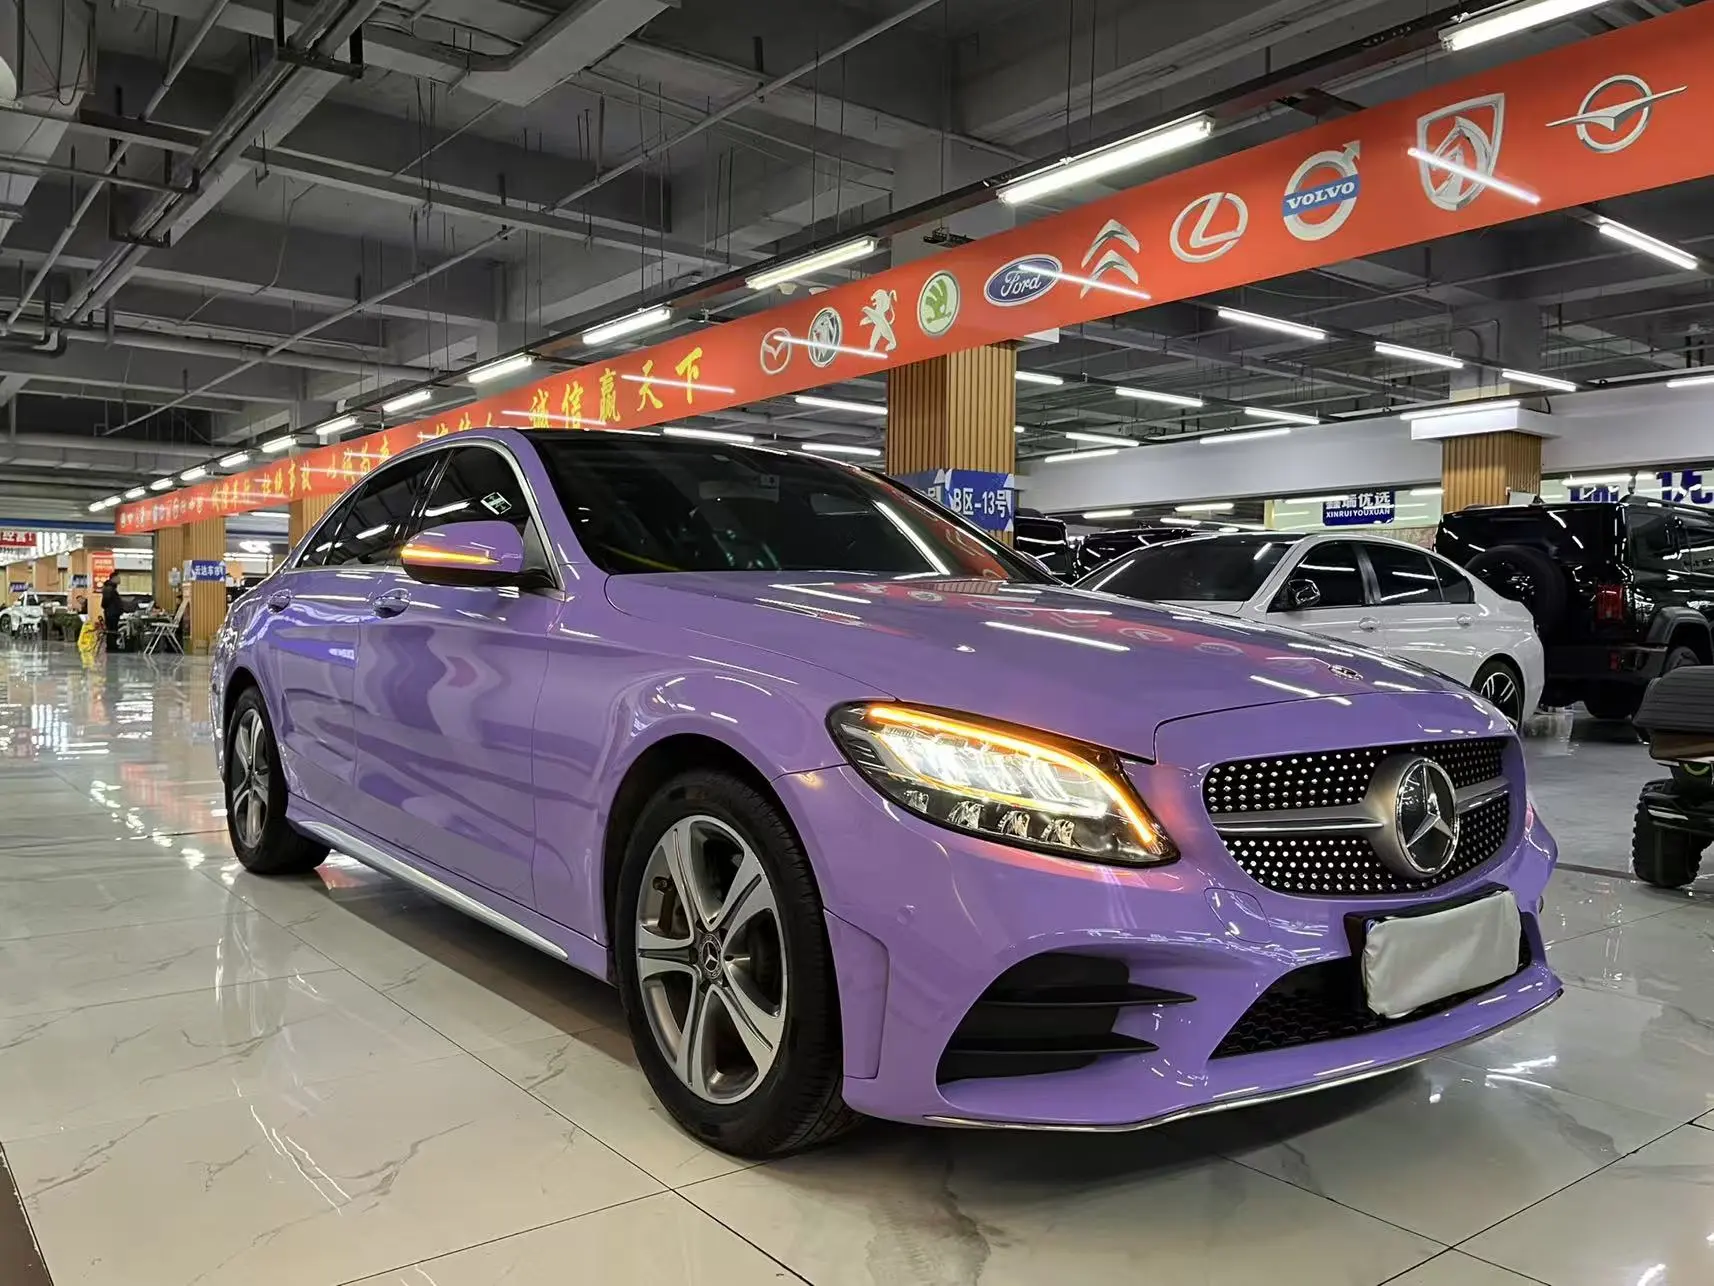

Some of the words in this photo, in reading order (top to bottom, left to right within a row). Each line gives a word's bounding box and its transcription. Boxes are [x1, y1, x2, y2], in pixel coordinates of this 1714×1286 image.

[1286, 181, 1355, 210] VOLVO
[1001, 271, 1041, 297] Ford
[953, 488, 1007, 518] B区-13号
